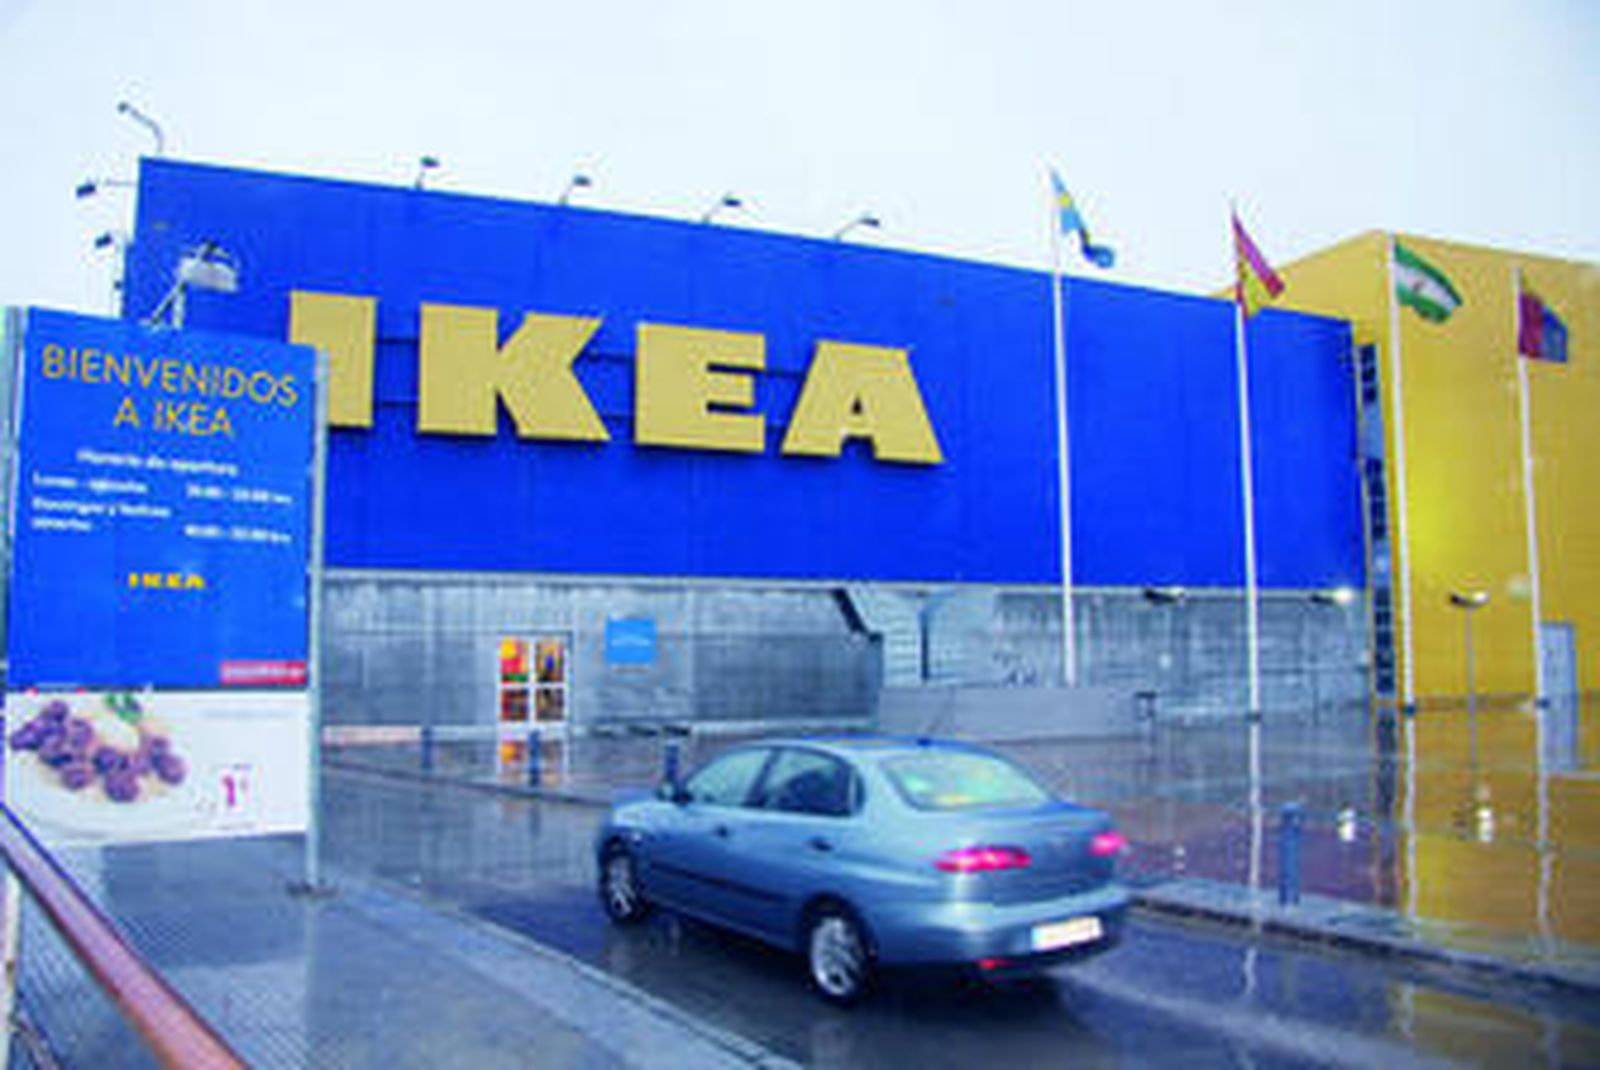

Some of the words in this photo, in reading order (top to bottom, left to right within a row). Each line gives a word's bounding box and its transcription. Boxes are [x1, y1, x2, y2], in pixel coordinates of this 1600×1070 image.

[41, 344, 298, 407] BIENVENIDOS
[288, 290, 945, 465] IKEA
[113, 397, 141, 428] A
[153, 400, 232, 437] IKEA
[127, 572, 205, 589] IKEA
